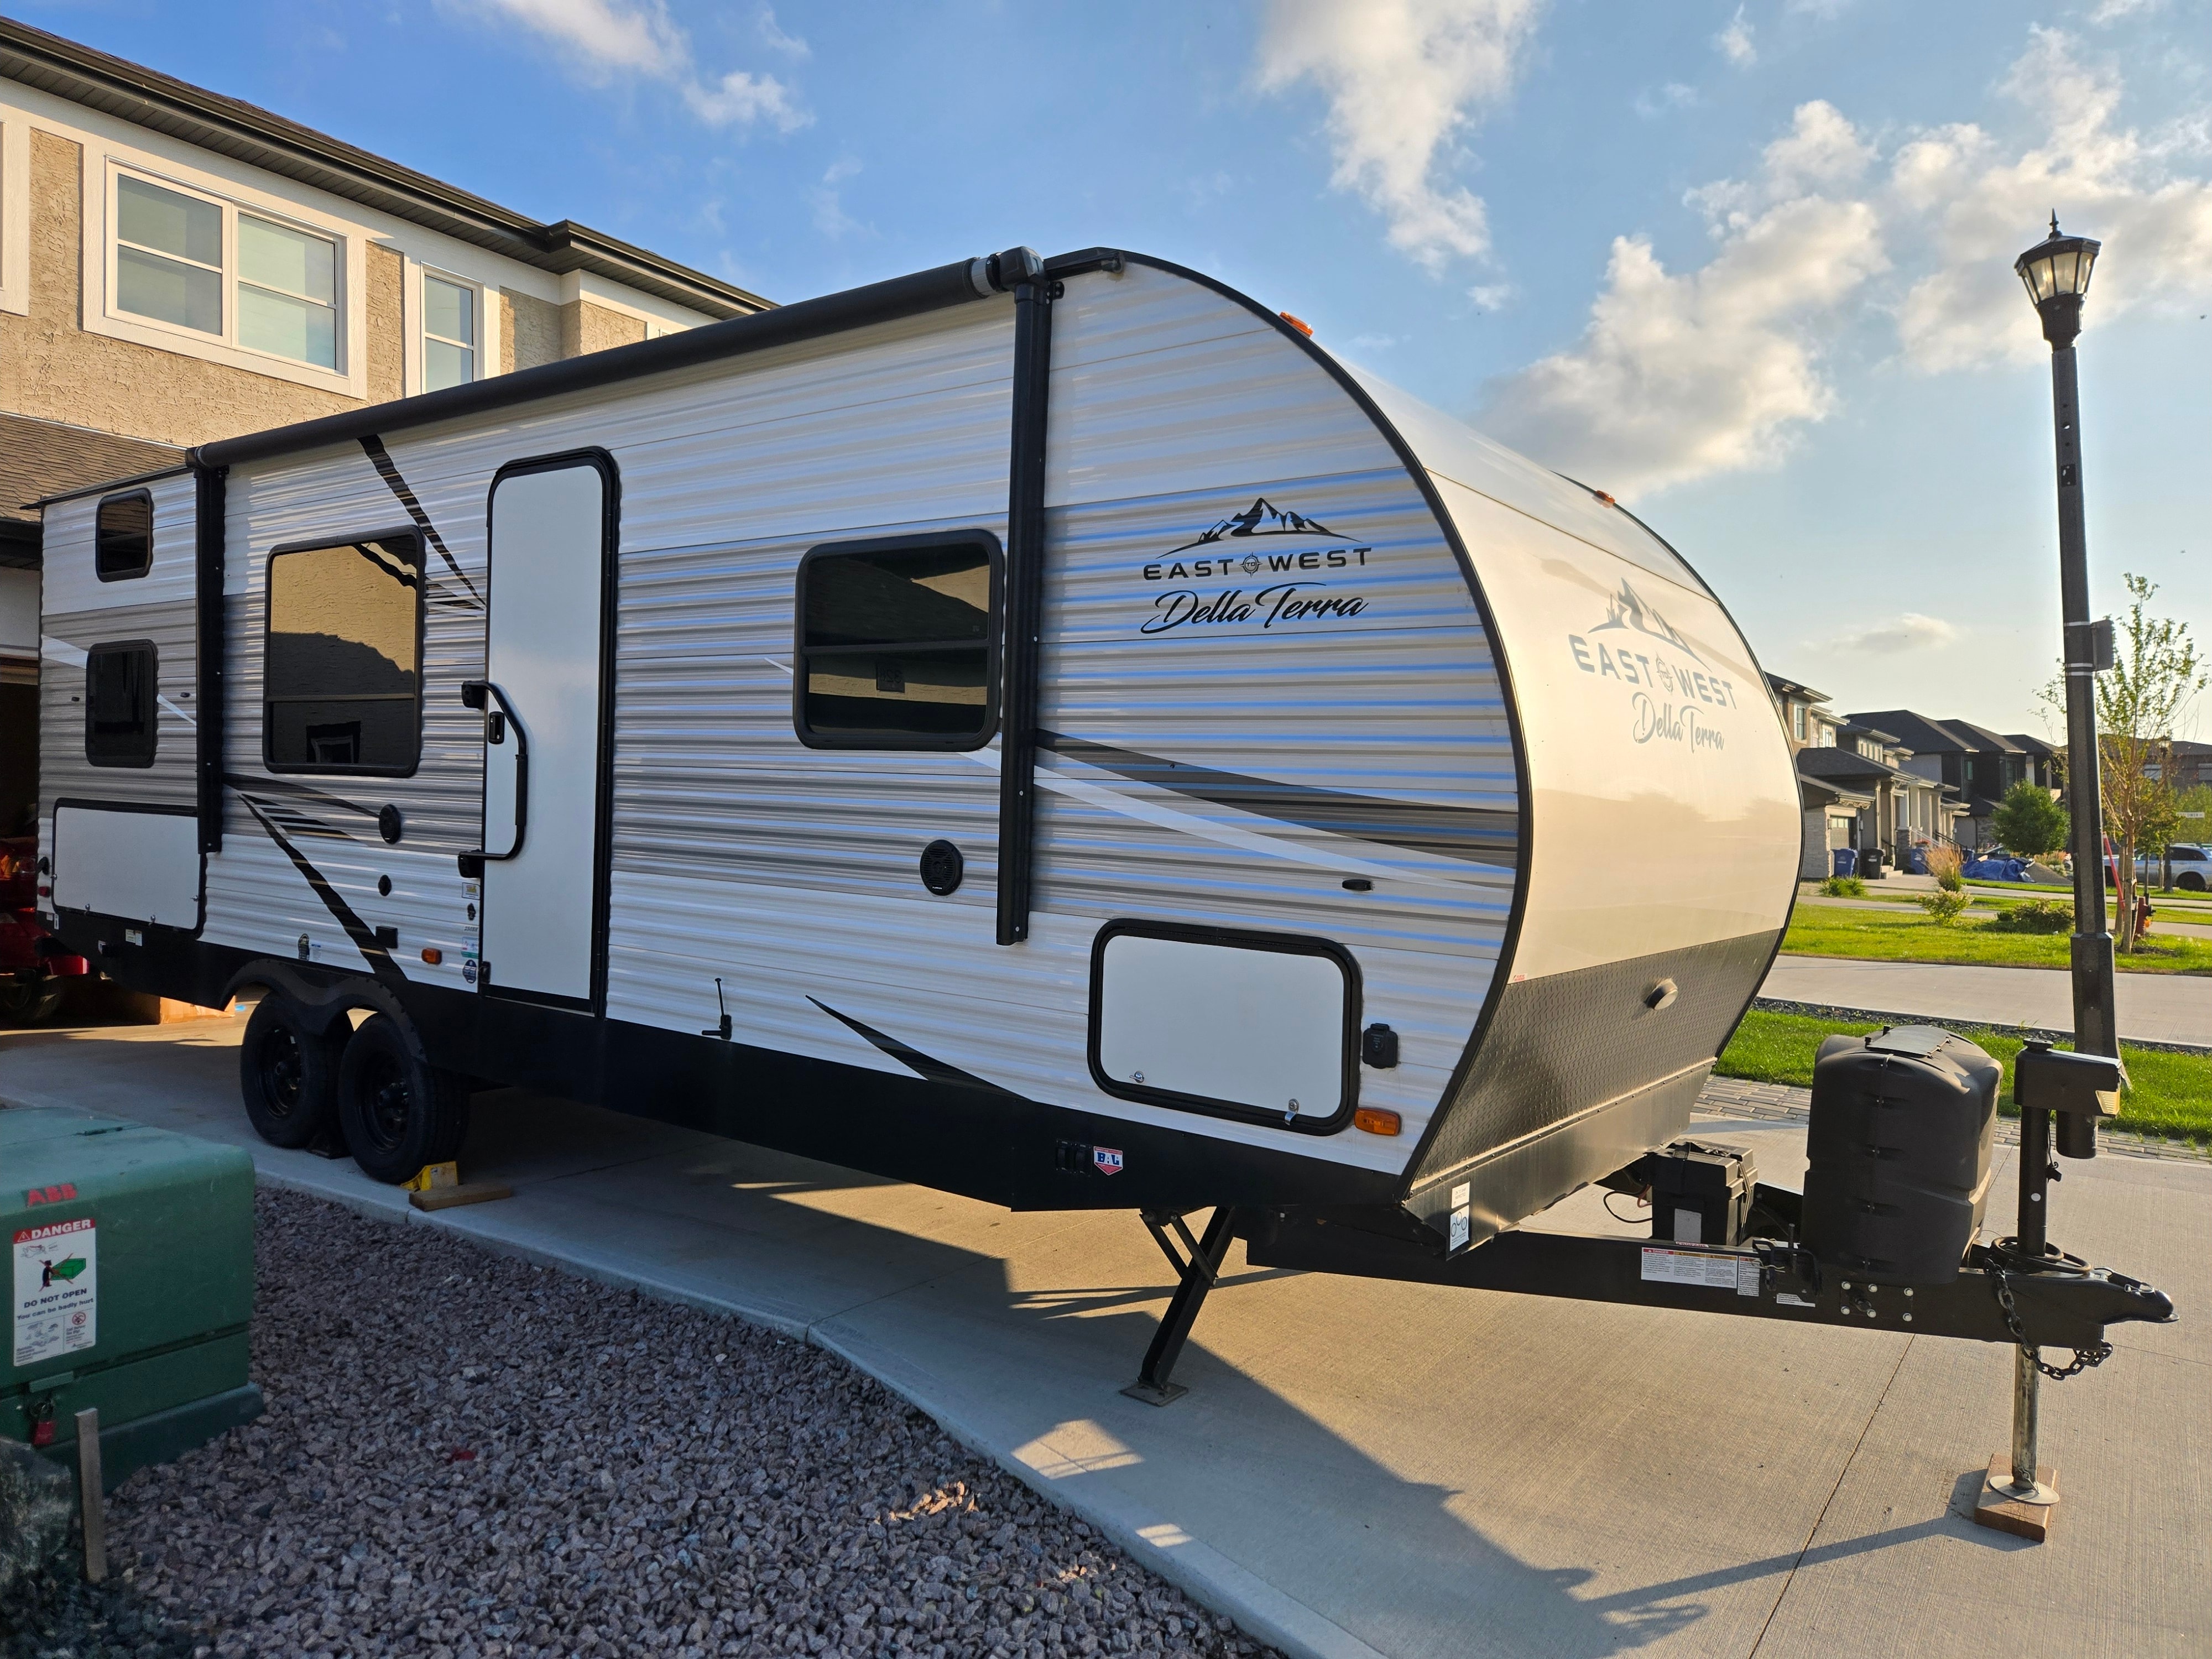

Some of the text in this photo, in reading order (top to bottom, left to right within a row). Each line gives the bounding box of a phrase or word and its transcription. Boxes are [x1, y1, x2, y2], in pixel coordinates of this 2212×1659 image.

[1143, 558, 1234, 581] EAST
[1267, 547, 1372, 572] WEST
[1140, 582, 1369, 634] Della Terra
[1568, 634, 1653, 688] EAST
[1671, 664, 1737, 710] WEST
[1631, 691, 1725, 754] Della Terra
[1097, 1151, 1120, 1166] BAL
[28, 1183, 77, 1207] ABB
[31, 1219, 91, 1239] DANGER
[24, 1287, 87, 1308] DO NOT OPEN
[58, 1302, 78, 1311] badly
[79, 1297, 94, 1306] hurt
